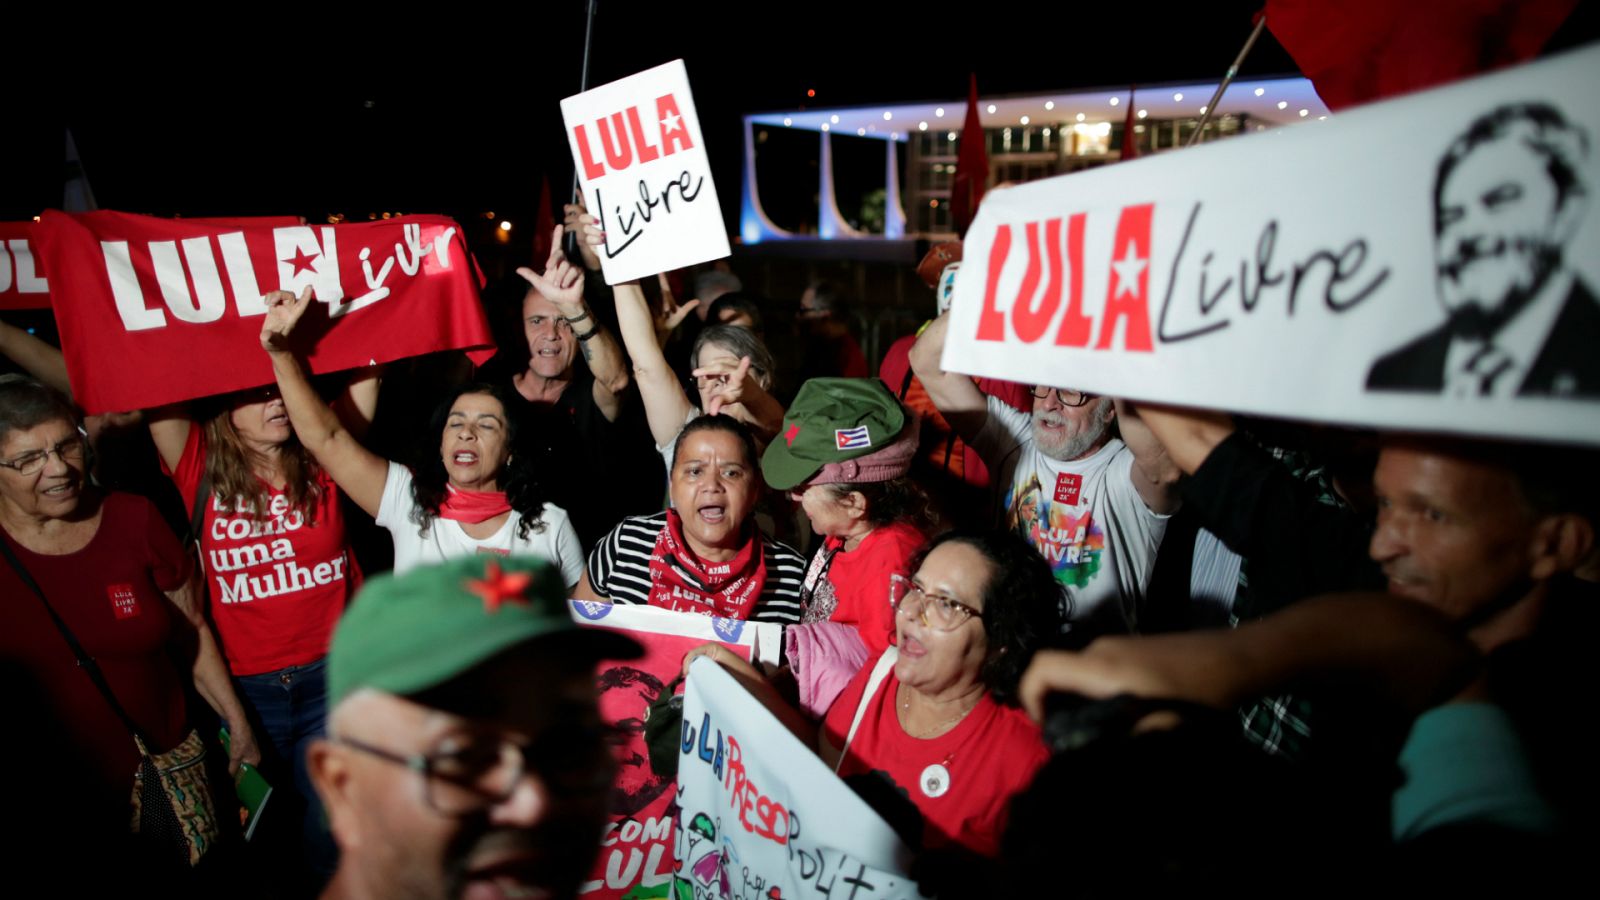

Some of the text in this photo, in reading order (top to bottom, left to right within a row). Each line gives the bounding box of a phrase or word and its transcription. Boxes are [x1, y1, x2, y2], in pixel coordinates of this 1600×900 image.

[573, 93, 695, 181] LULA
[596, 170, 704, 259] Livre
[100, 225, 345, 331] LULA
[976, 200, 1392, 353] LULA Livre
[209, 538, 295, 572] uma
[672, 585, 716, 608] LULA
[581, 843, 674, 894] UL
